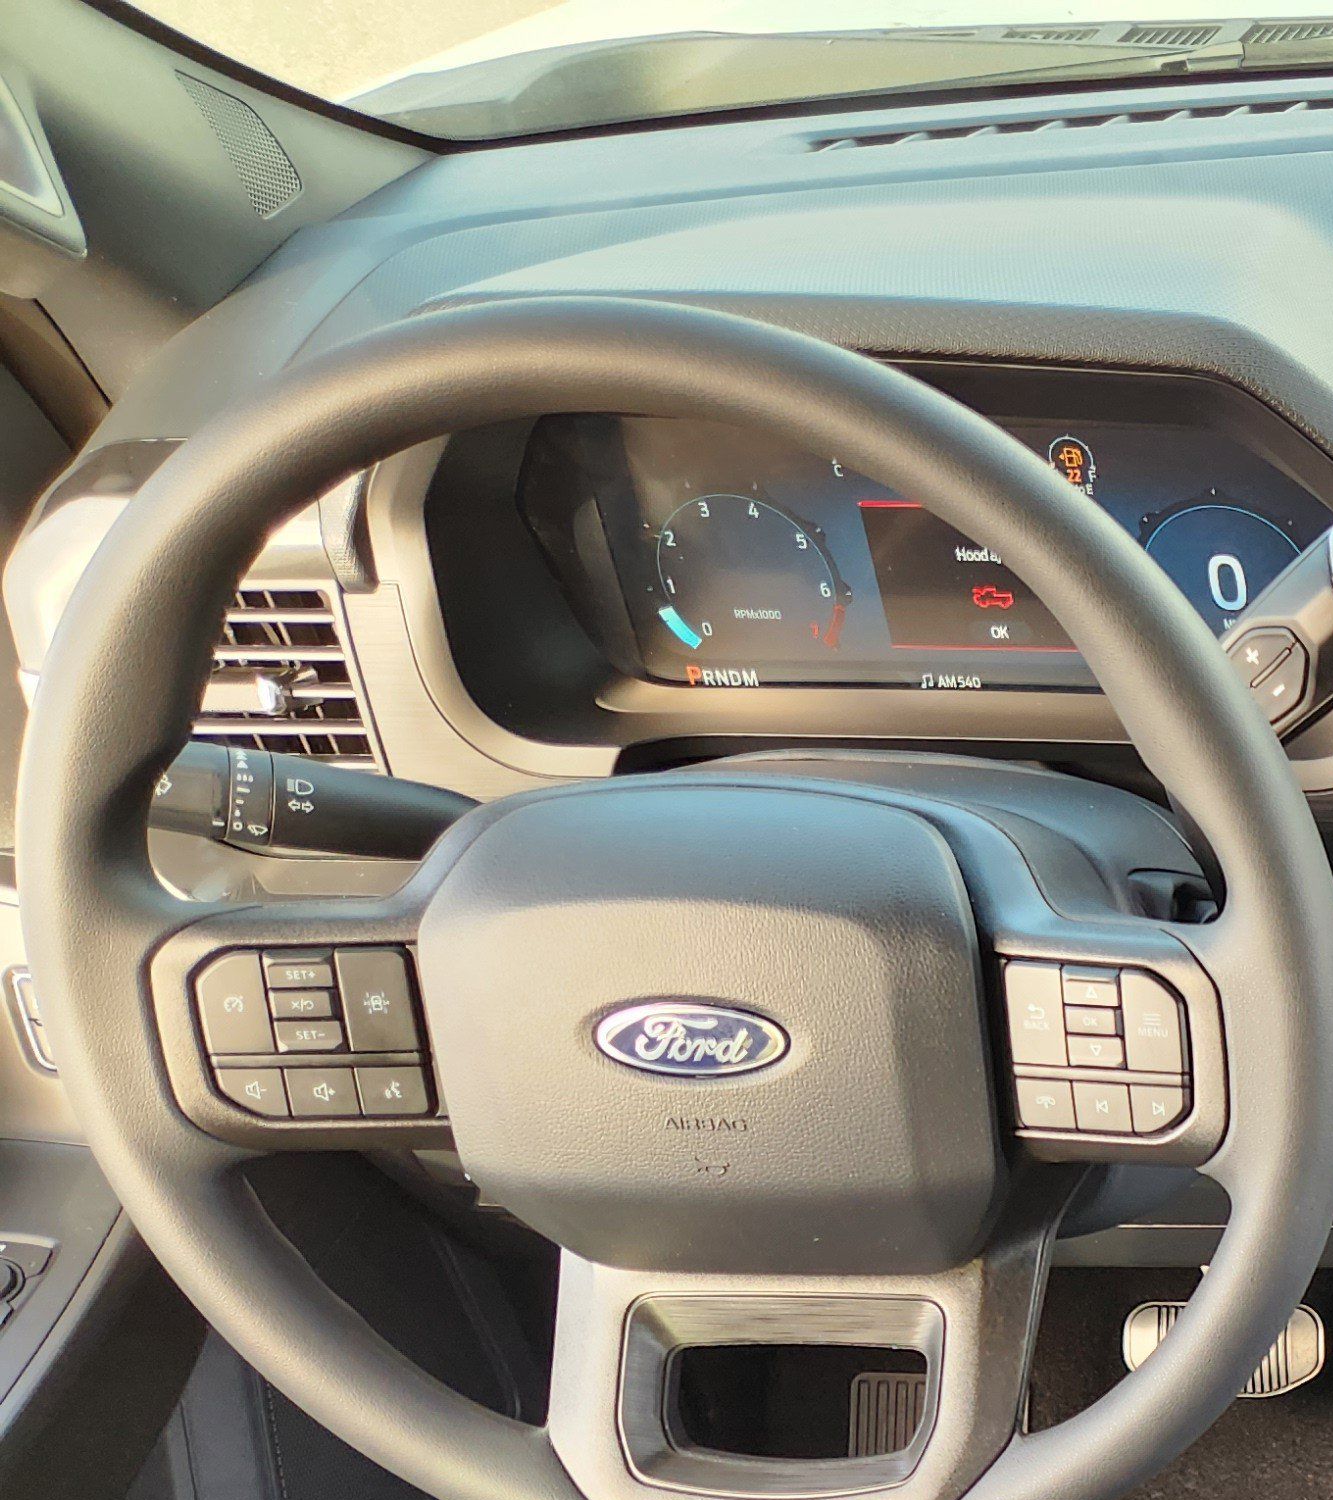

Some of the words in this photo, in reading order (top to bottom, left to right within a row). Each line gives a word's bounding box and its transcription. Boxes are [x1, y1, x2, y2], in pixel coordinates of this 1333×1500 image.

[697, 502, 710, 518] 3
[748, 502, 760, 518] 4
[664, 531, 677, 547] 2
[795, 533, 808, 549] 5
[955, 546, 989, 562] Hood
[666, 577, 676, 594] 1
[820, 582, 832, 598] 6
[1208, 554, 1247, 611] 0
[701, 622, 713, 636] 0
[990, 625, 1010, 639] OK
[1022, 1019, 1051, 1032] BACK
[1082, 1017, 1099, 1027] OK
[634, 1014, 750, 1065] Ford
[1137, 1026, 1170, 1039] MENU
